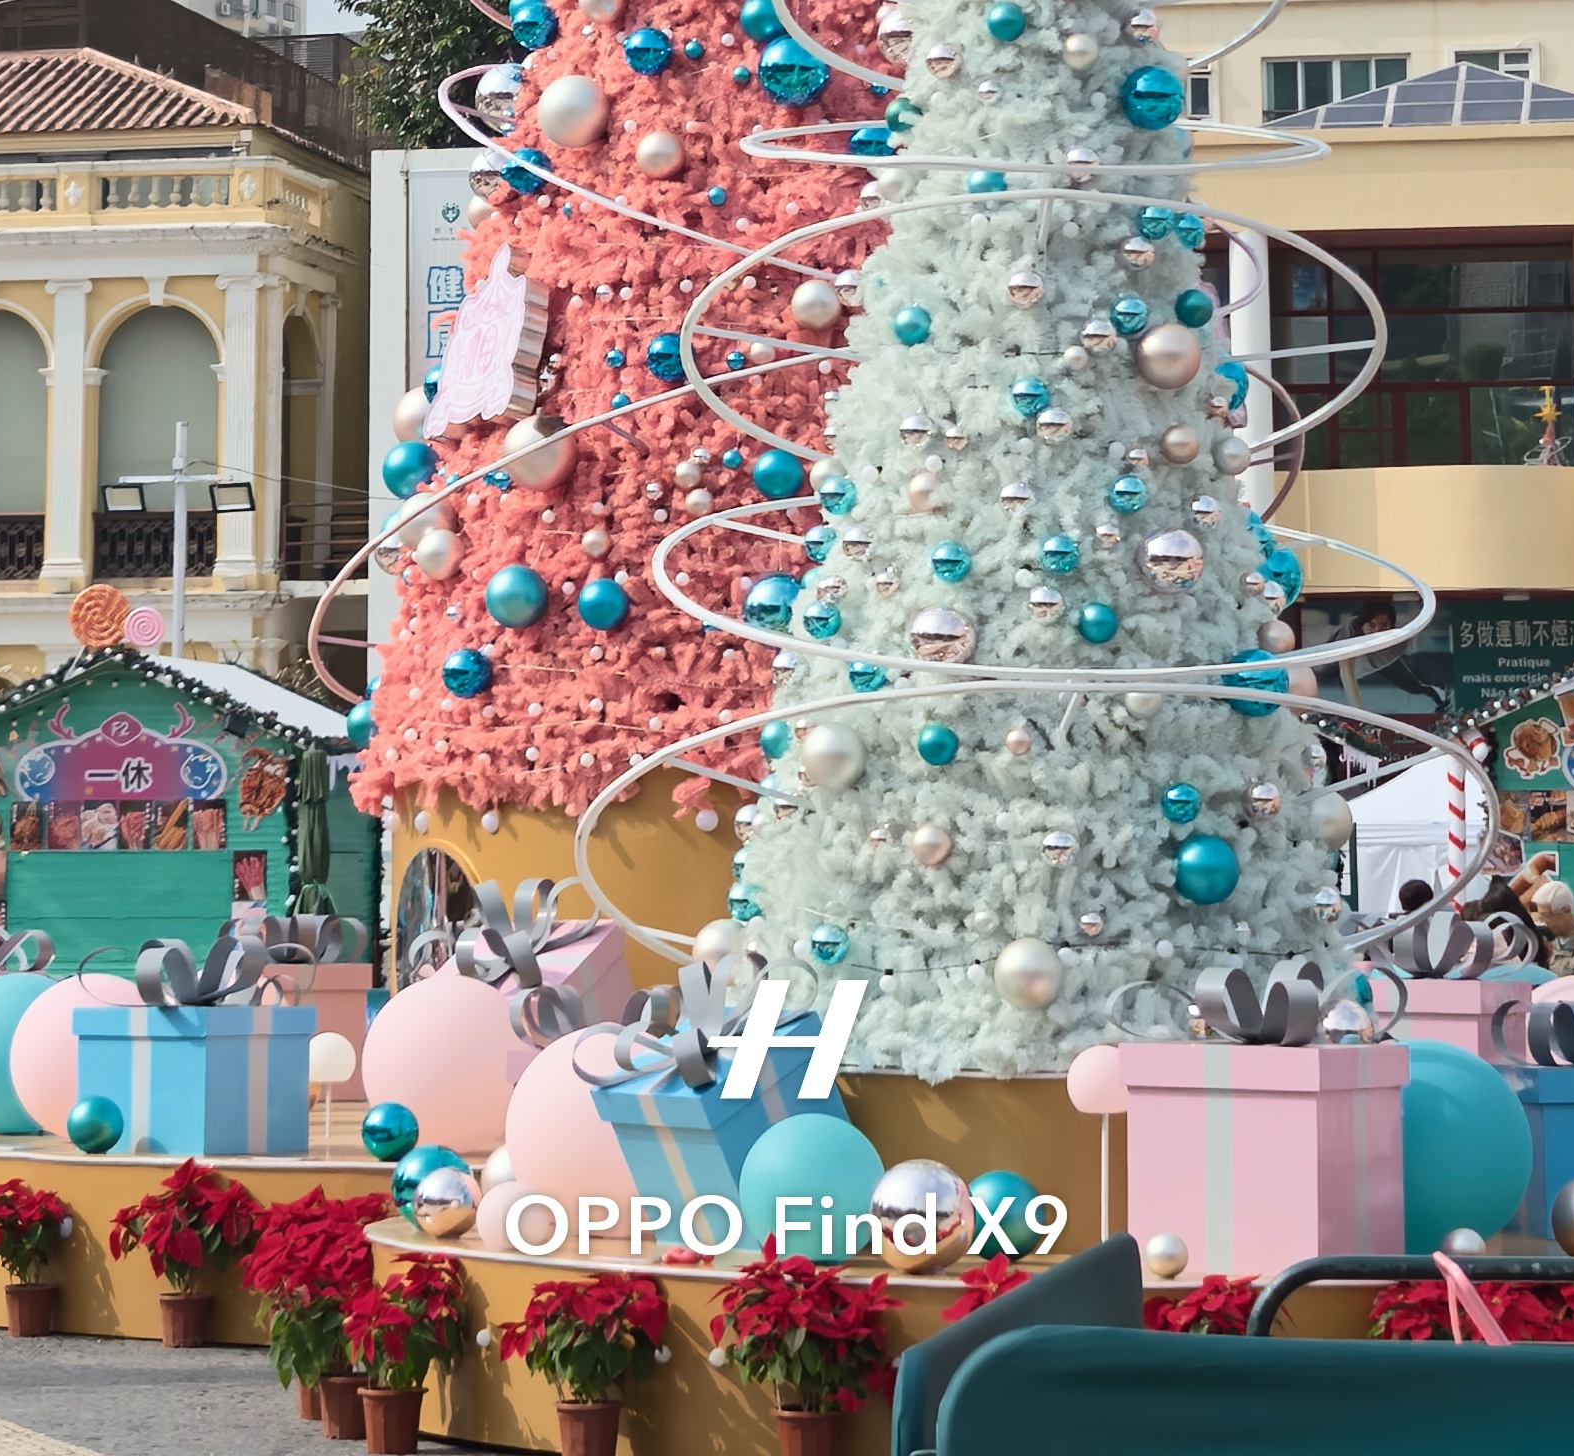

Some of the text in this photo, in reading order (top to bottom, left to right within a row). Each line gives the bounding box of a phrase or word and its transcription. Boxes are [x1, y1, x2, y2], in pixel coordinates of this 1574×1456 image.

[1498, 657, 1550, 668] Pratique
[1463, 673, 1491, 683] mais
[110, 721, 131, 737] F2
[88, 759, 150, 790] 一休
